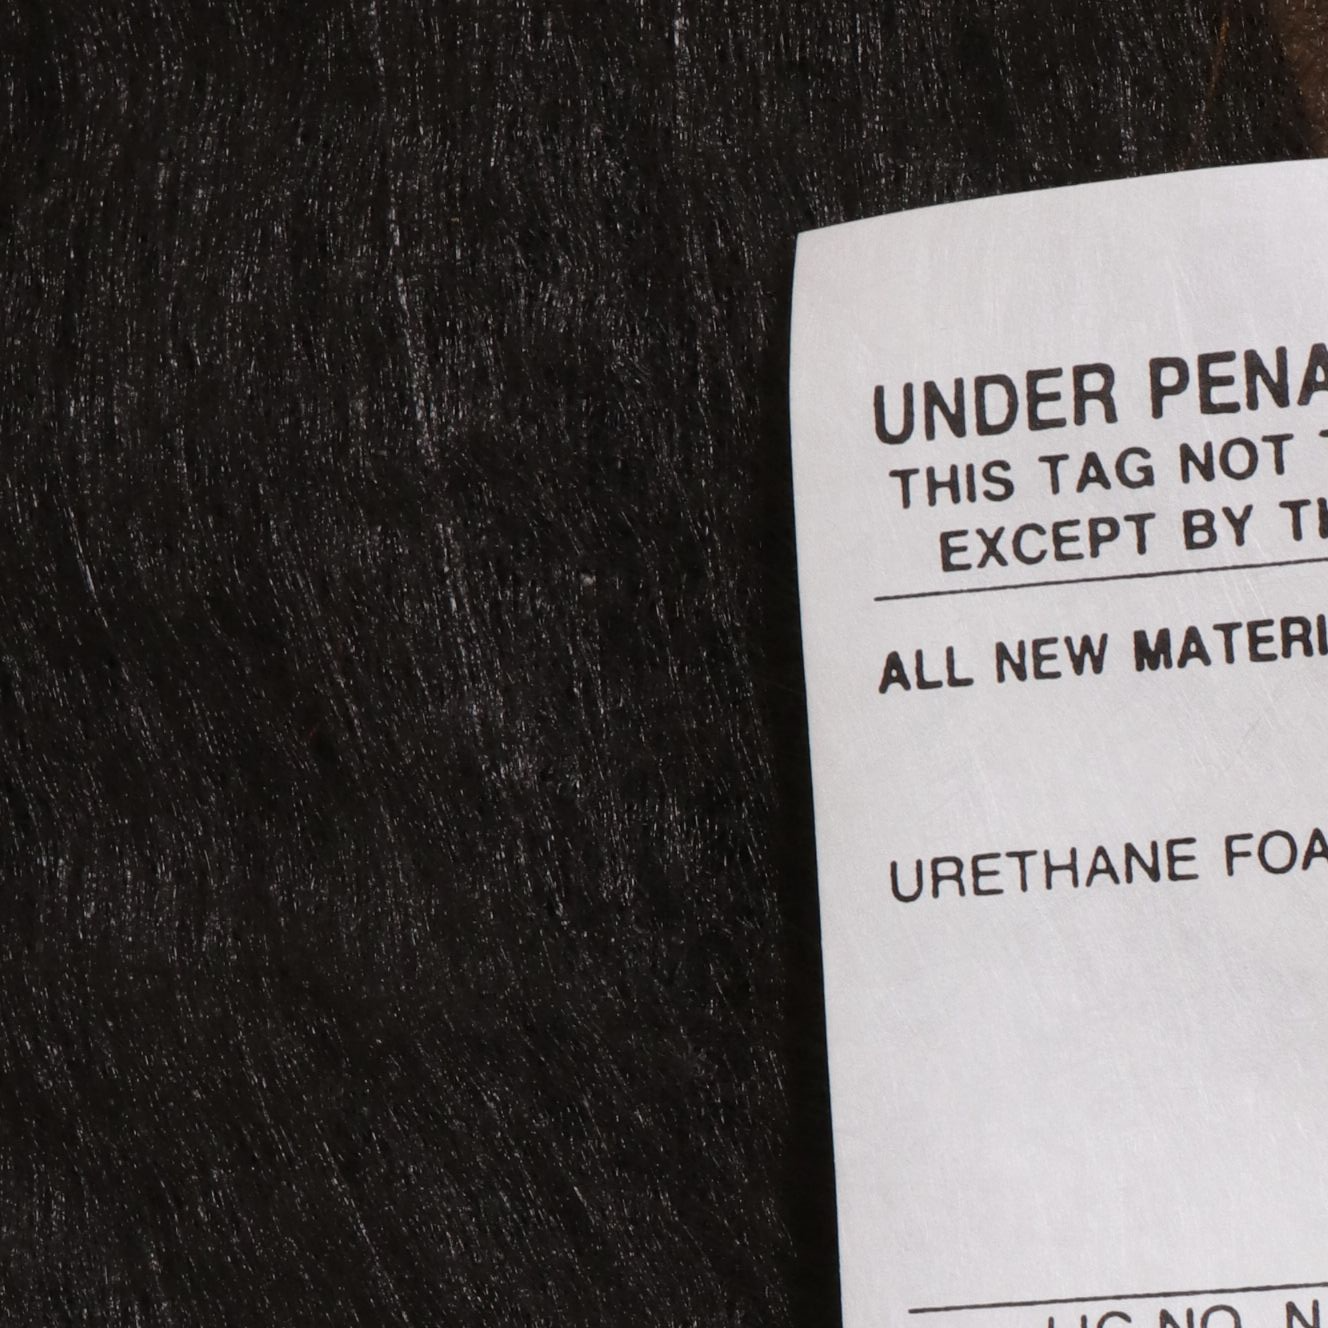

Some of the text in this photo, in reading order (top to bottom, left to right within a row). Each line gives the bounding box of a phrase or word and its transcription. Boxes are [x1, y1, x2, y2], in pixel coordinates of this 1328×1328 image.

[873, 363, 1118, 445] UNDER
[889, 460, 1014, 509] THIS
[1038, 447, 1155, 495] TAG
[1179, 433, 1294, 484] NOT
[940, 512, 1156, 572] EXCEPT
[1183, 504, 1253, 550] BY
[879, 646, 974, 694] ALL
[996, 633, 1108, 683] NEW
[890, 837, 1199, 903] URETHANE
